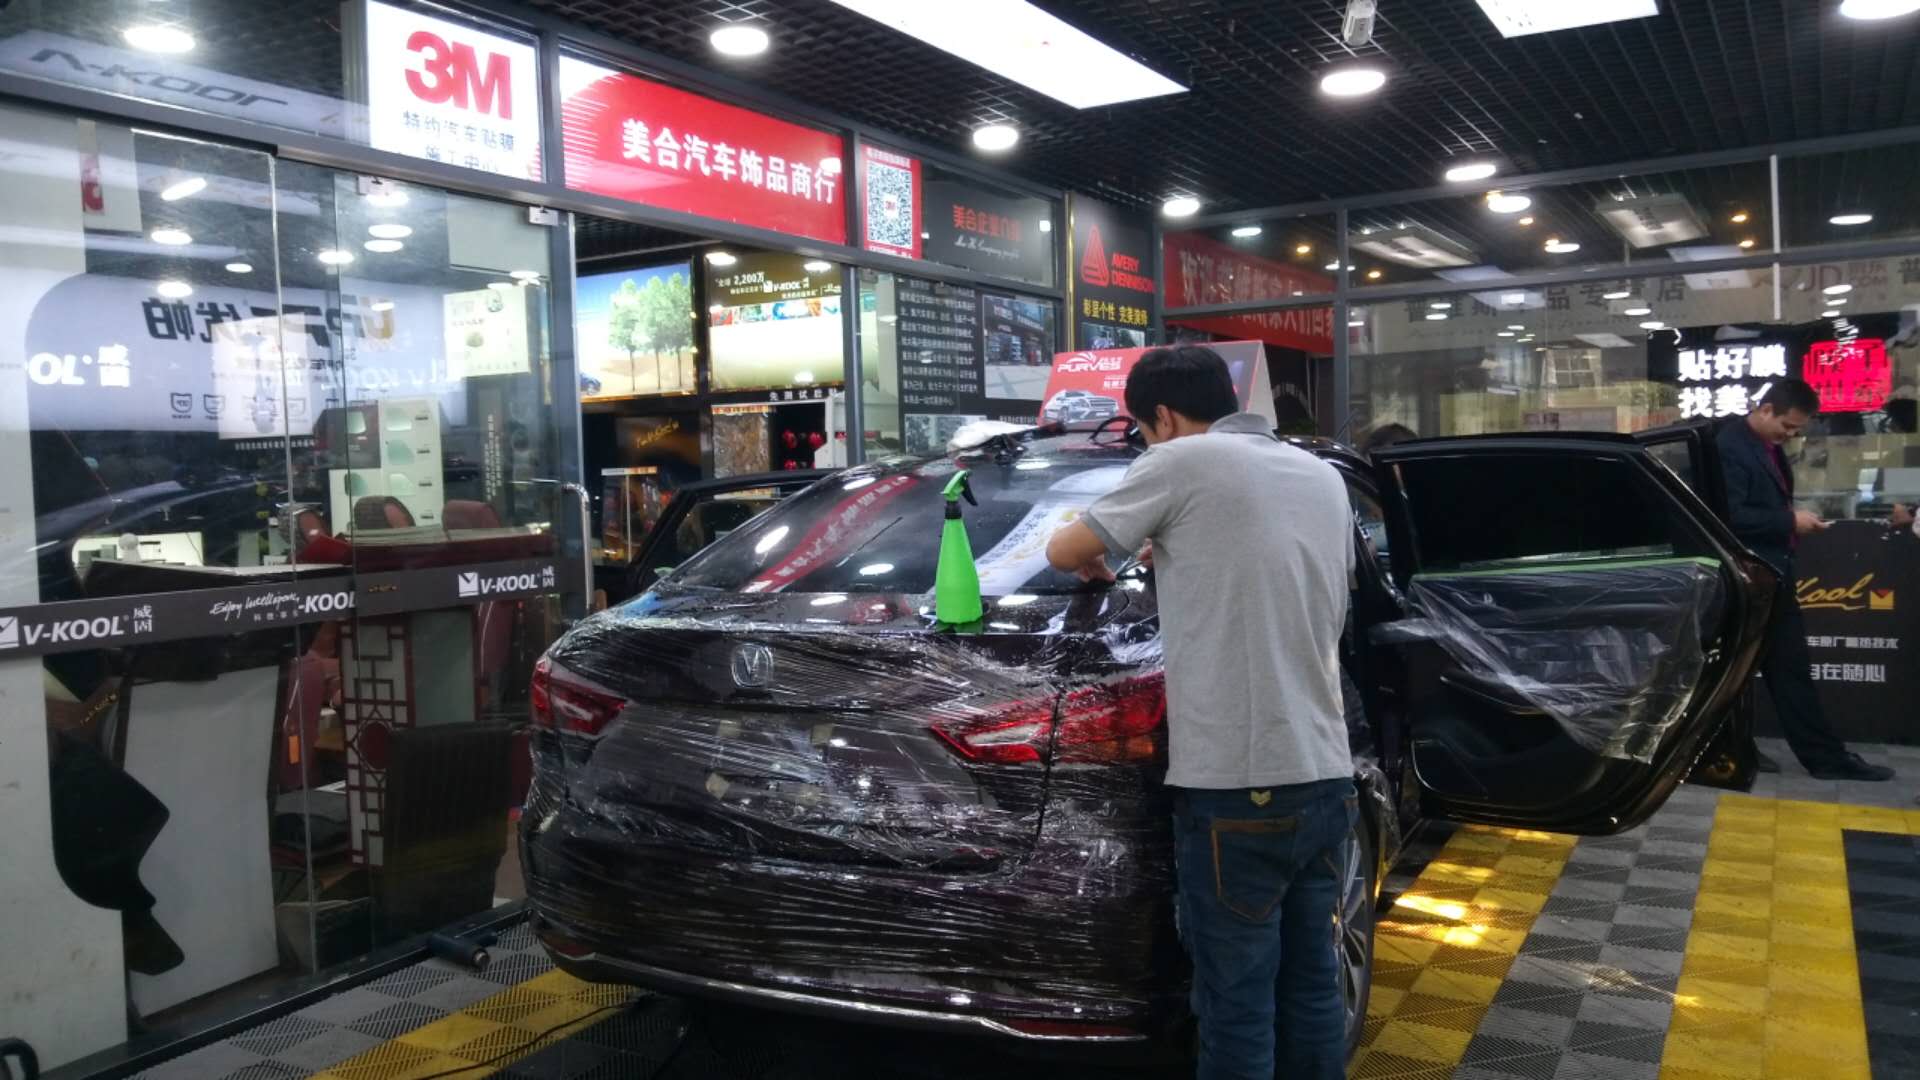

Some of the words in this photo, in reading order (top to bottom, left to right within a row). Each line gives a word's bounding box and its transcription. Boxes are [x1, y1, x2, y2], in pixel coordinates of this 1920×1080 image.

[405, 31, 512, 120] 3M
[403, 110, 514, 151] 特约汽车贴膜
[622, 118, 836, 204] 美合汽车饰品商行
[1112, 252, 1139, 272] AVERY
[480, 574, 538, 594] V-KOOL
[209, 600, 243, 622] Enjoy
[23, 616, 125, 645] V-KOOL
